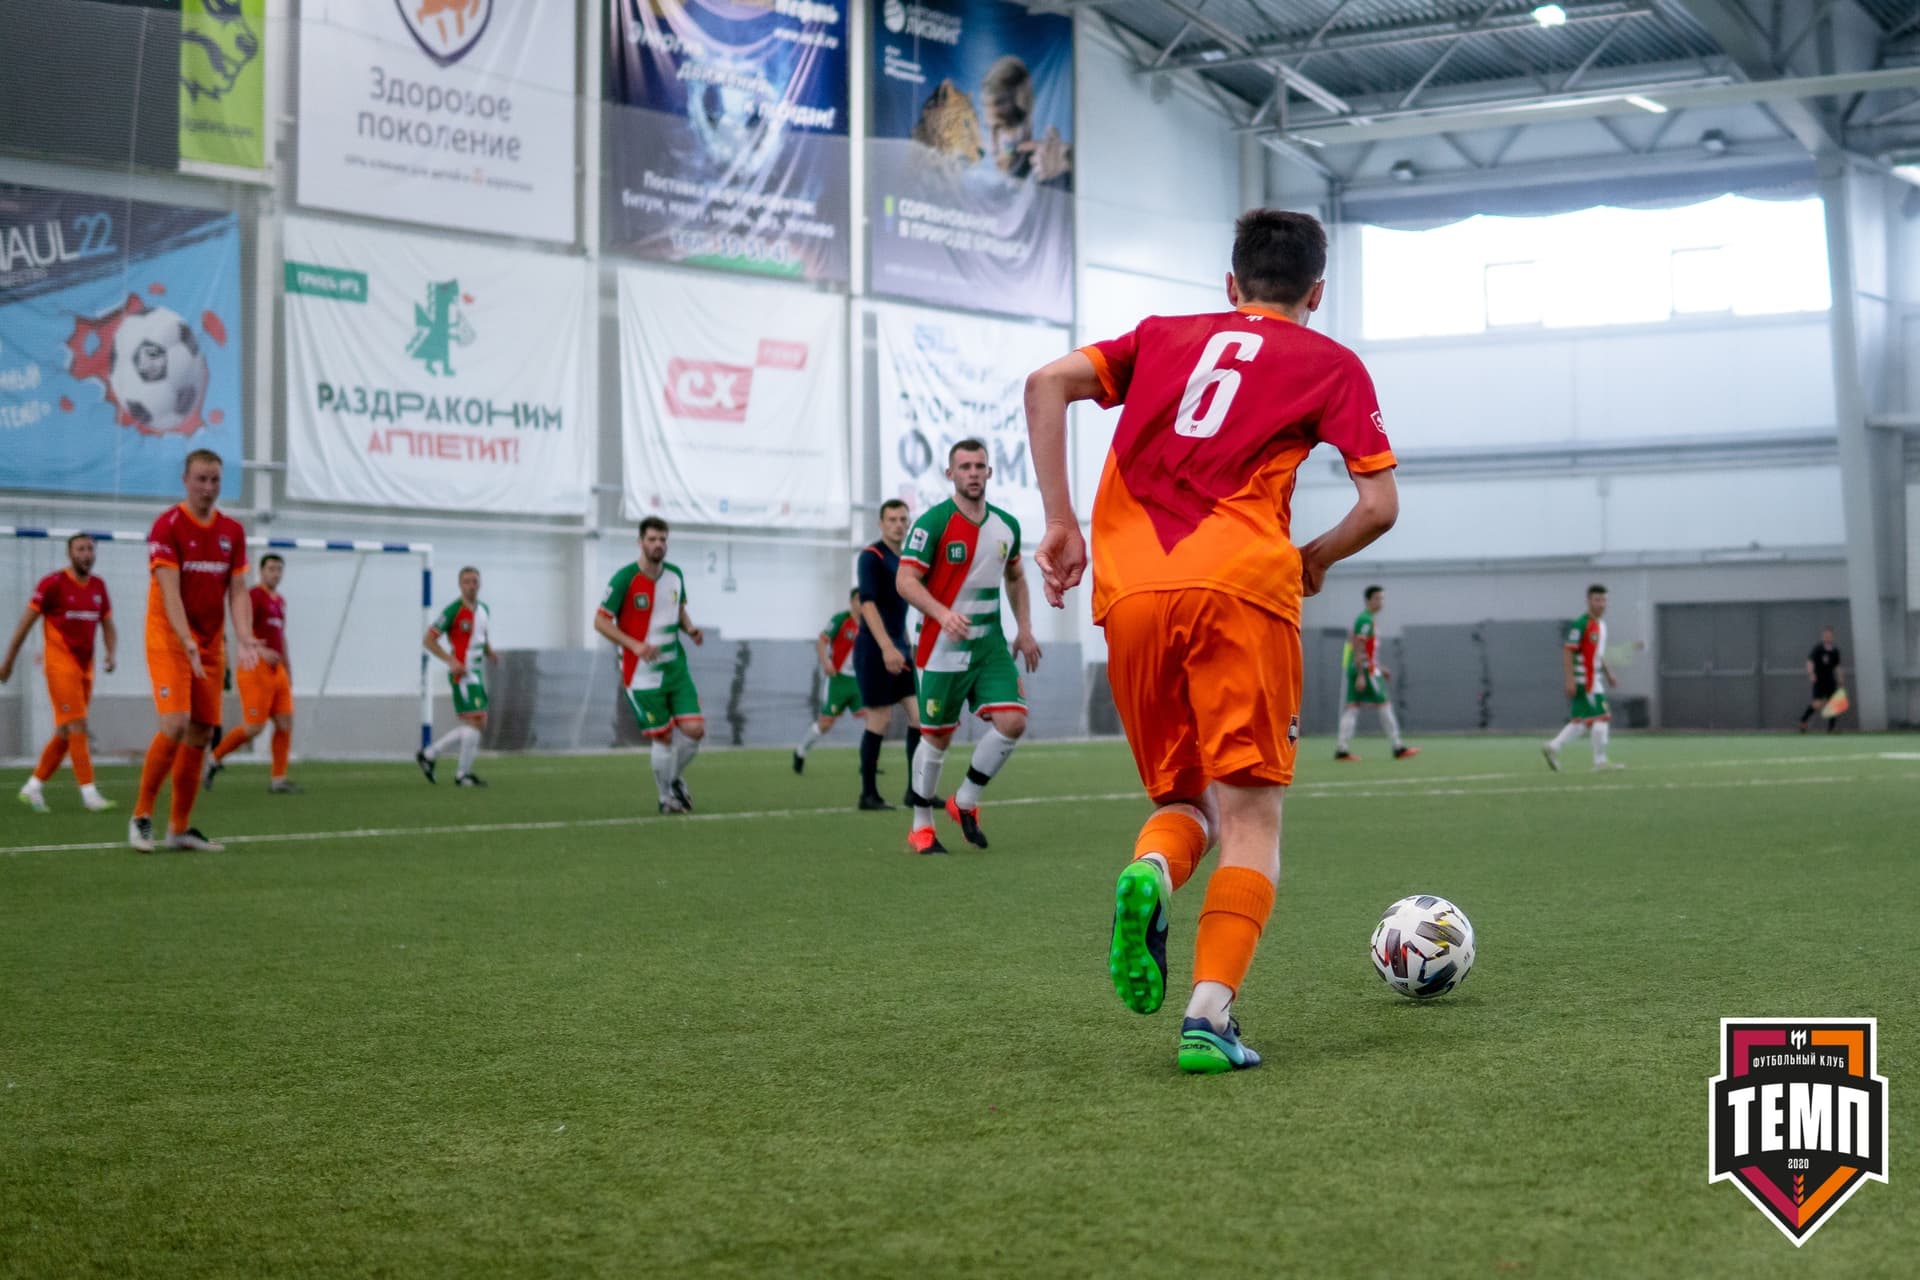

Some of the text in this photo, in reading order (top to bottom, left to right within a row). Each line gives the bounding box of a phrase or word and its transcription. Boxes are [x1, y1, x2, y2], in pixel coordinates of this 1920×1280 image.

[370, 66, 512, 122] Здоровое
[357, 111, 522, 162] поколение
[317, 382, 563, 431] РАЗДРАКОНИМ
[1174, 330, 1264, 439] 6
[367, 428, 520, 464] АППЕТИТ!
